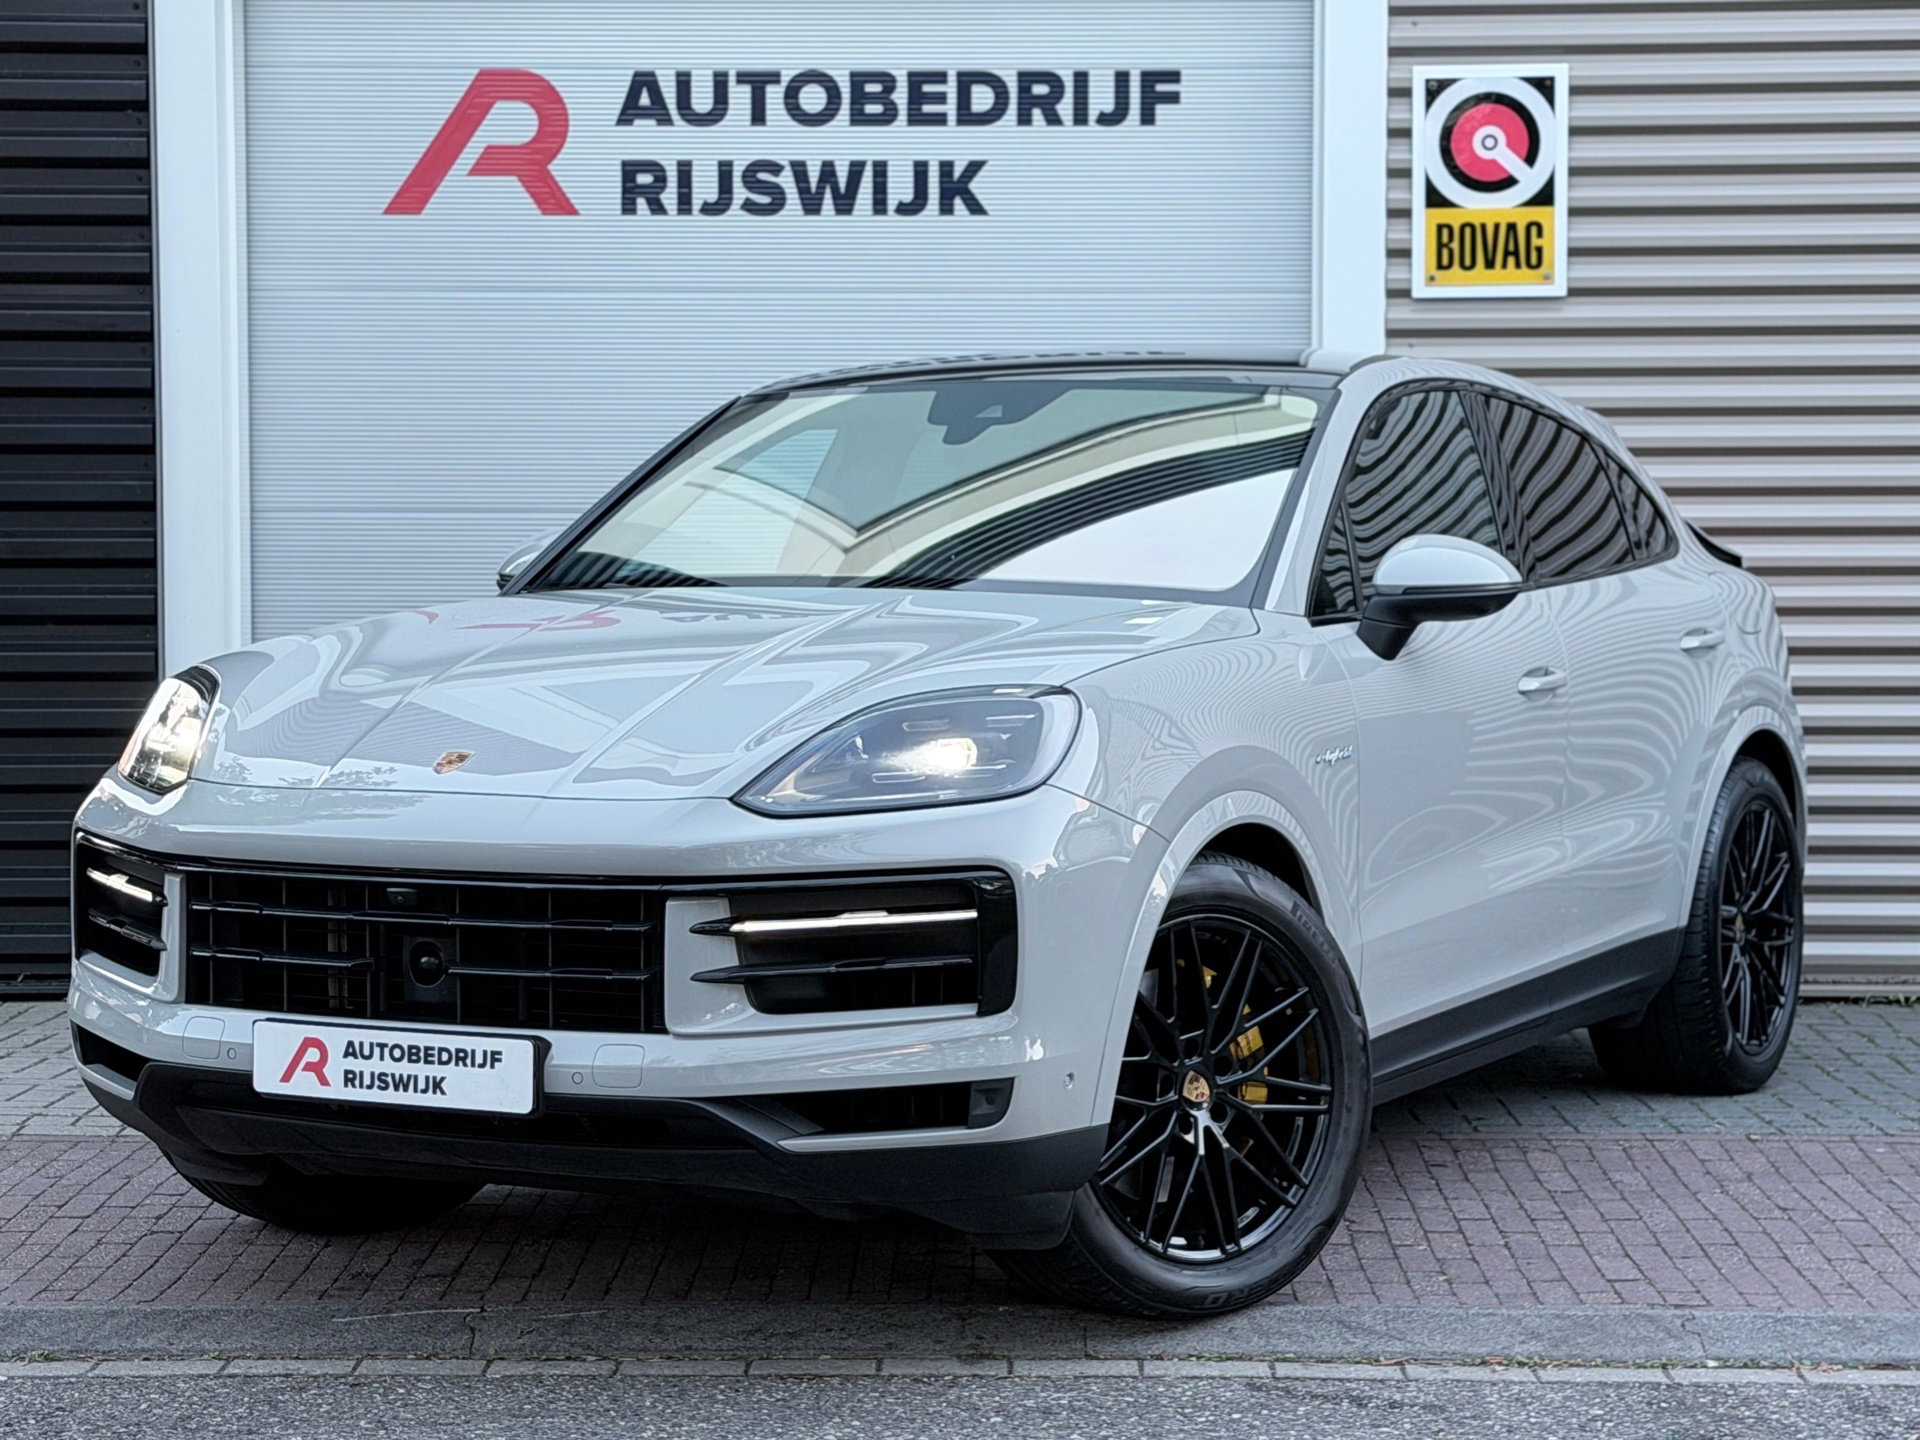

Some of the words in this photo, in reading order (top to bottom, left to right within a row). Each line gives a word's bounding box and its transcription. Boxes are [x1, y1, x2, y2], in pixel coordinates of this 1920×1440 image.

[616, 70, 1181, 127] AUTOBEDRIJF
[621, 160, 987, 216] RIJSWIJK
[1437, 221, 1542, 270] BOVAG
[343, 1040, 503, 1069] AUTOBEDRIJF
[343, 1069, 447, 1096] RIJSWIJK
